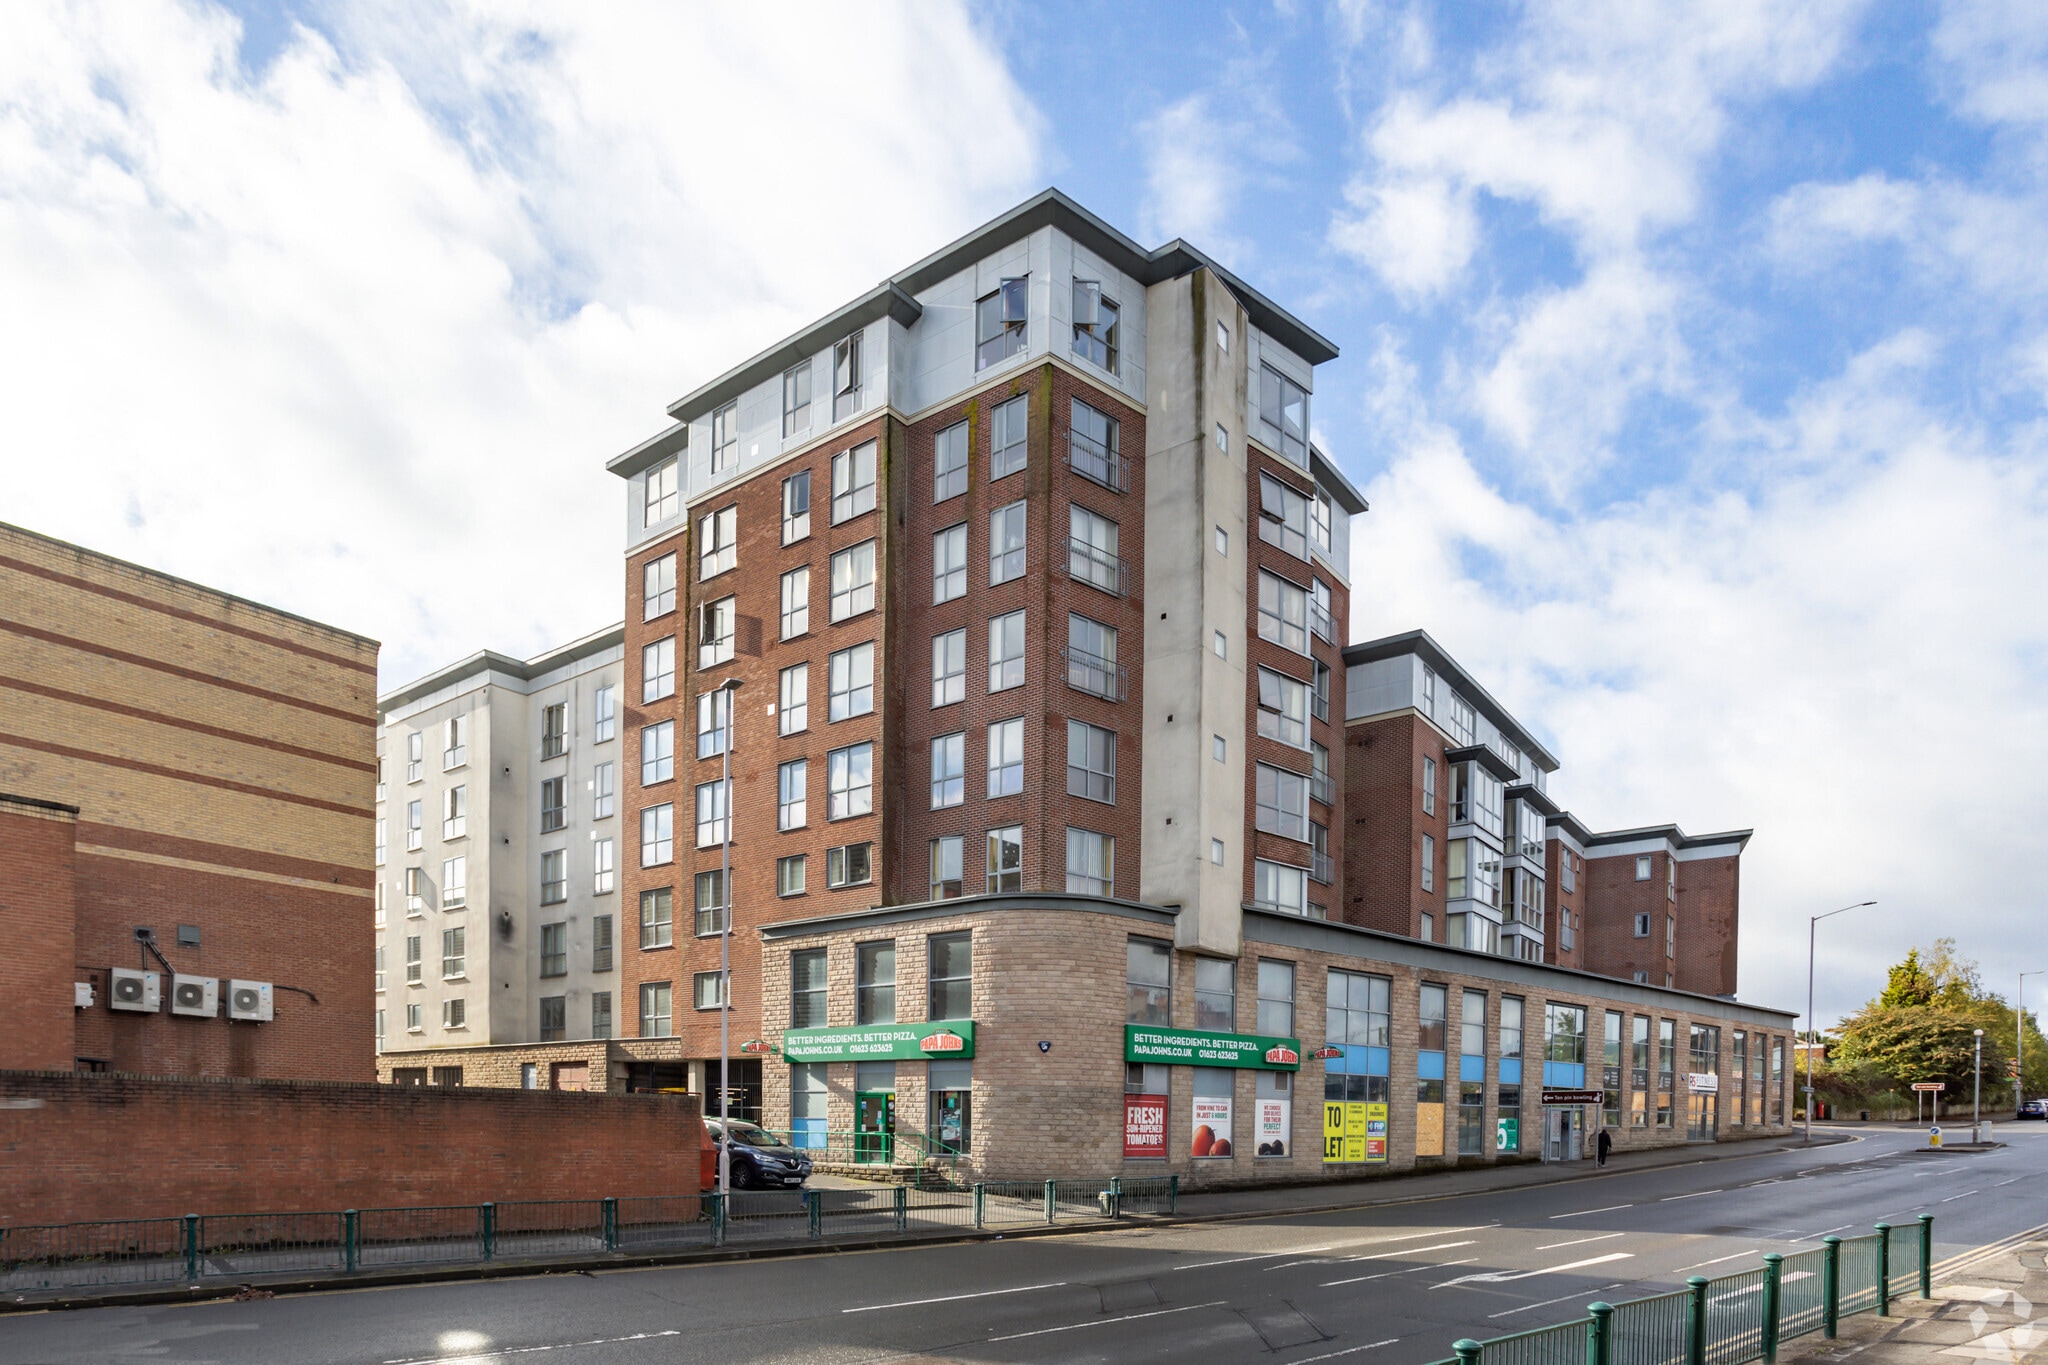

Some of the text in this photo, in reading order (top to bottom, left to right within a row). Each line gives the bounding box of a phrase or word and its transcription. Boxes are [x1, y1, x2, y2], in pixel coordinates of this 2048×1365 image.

[788, 1032, 917, 1045] BETTER INGREDIENTS. BETTER PIZZA.
[921, 1036, 938, 1049] PAPA
[1134, 1033, 1259, 1051] BETTER INGREDIENTS. BETTER PIZZA.
[788, 1044, 893, 1055] PAPAJOHNS.CO.UK 01623 623625
[1134, 1044, 1238, 1060] PAPAJOHNS.CO.UK 01623 623625
[1267, 1050, 1279, 1061] PAPA
[1128, 1106, 1163, 1124] FRESH
[1328, 1106, 1341, 1128] TO
[1126, 1124, 1163, 1133] SUN-RIPENED
[1126, 1134, 1163, 1145] TOMATOES
[1324, 1137, 1343, 1157] LET
